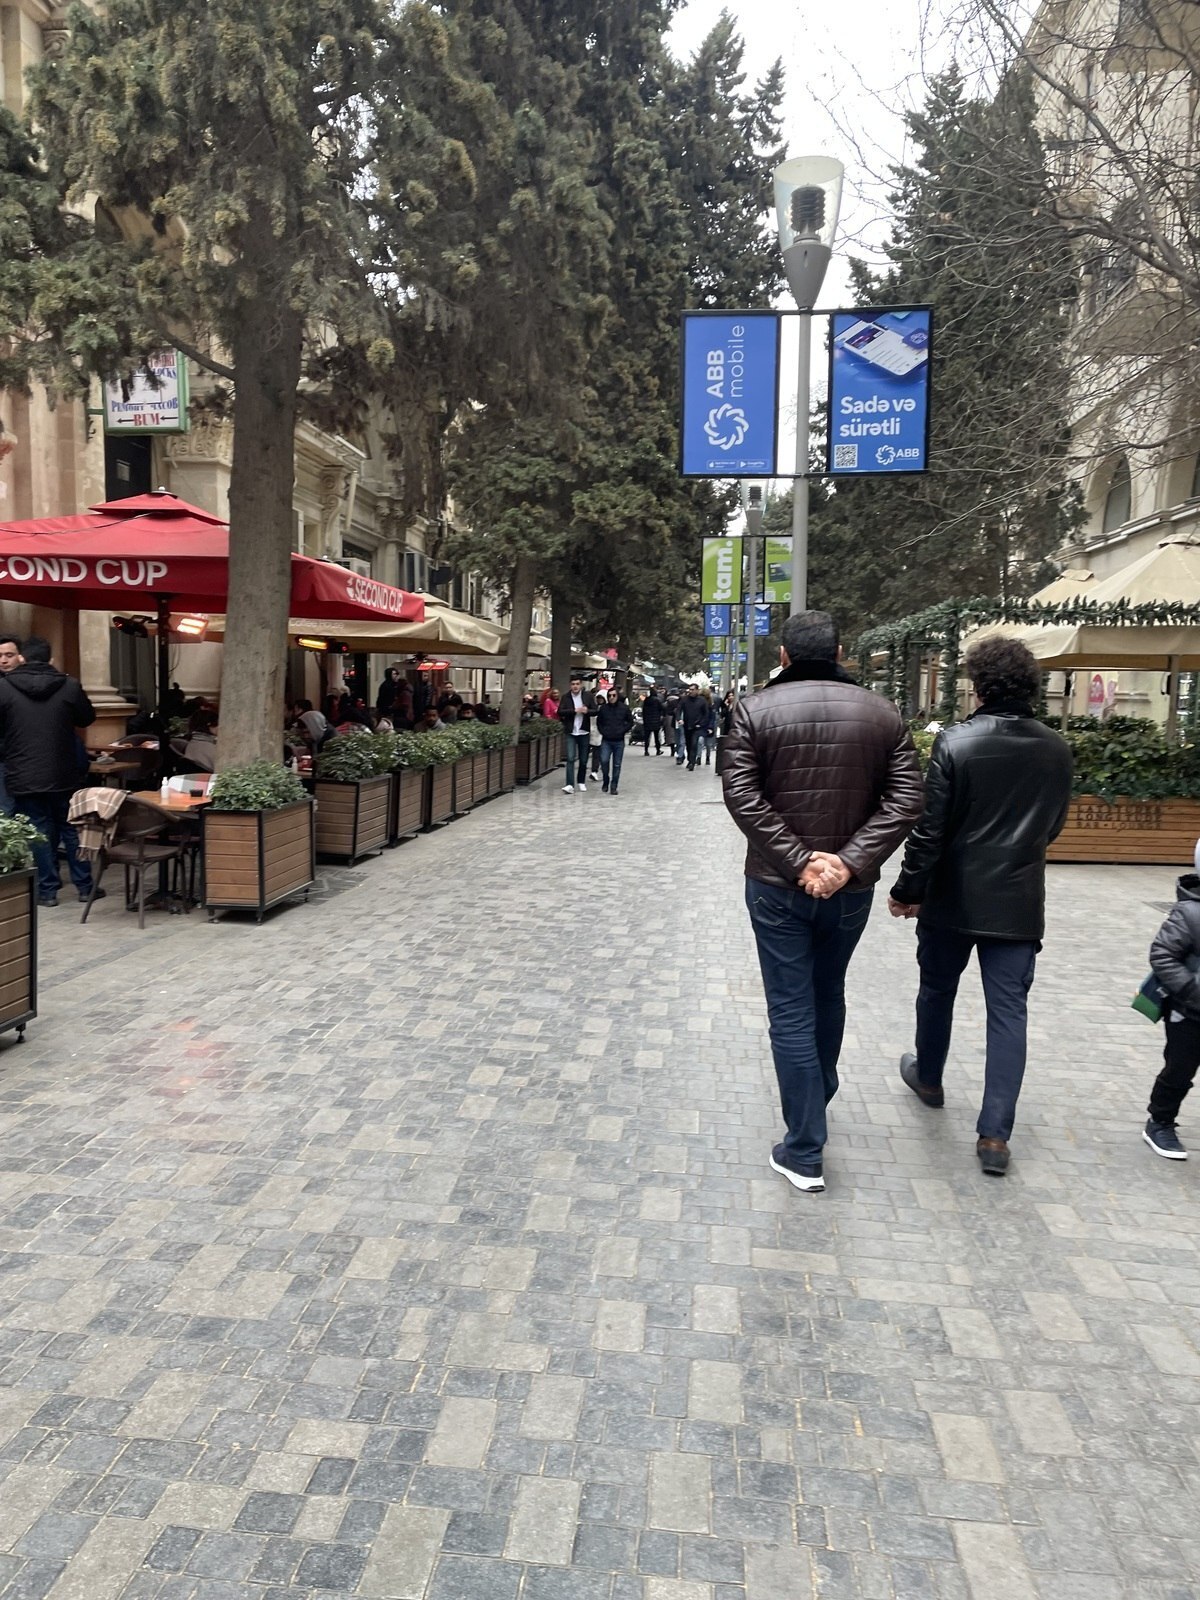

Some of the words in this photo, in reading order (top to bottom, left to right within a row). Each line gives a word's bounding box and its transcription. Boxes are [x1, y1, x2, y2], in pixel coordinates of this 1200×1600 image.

[706, 350, 724, 398] ABB
[727, 325, 745, 397] mobile
[840, 395, 890, 414] Sadə
[892, 398, 916, 412] və
[839, 418, 900, 437] sürətli
[895, 448, 920, 458] ABB
[95, 559, 168, 586] CUP
[712, 540, 733, 600] tam.
[354, 578, 388, 611] SECOND
[388, 591, 404, 614] CUP
[1077, 813, 1162, 822] LONGITUDE
